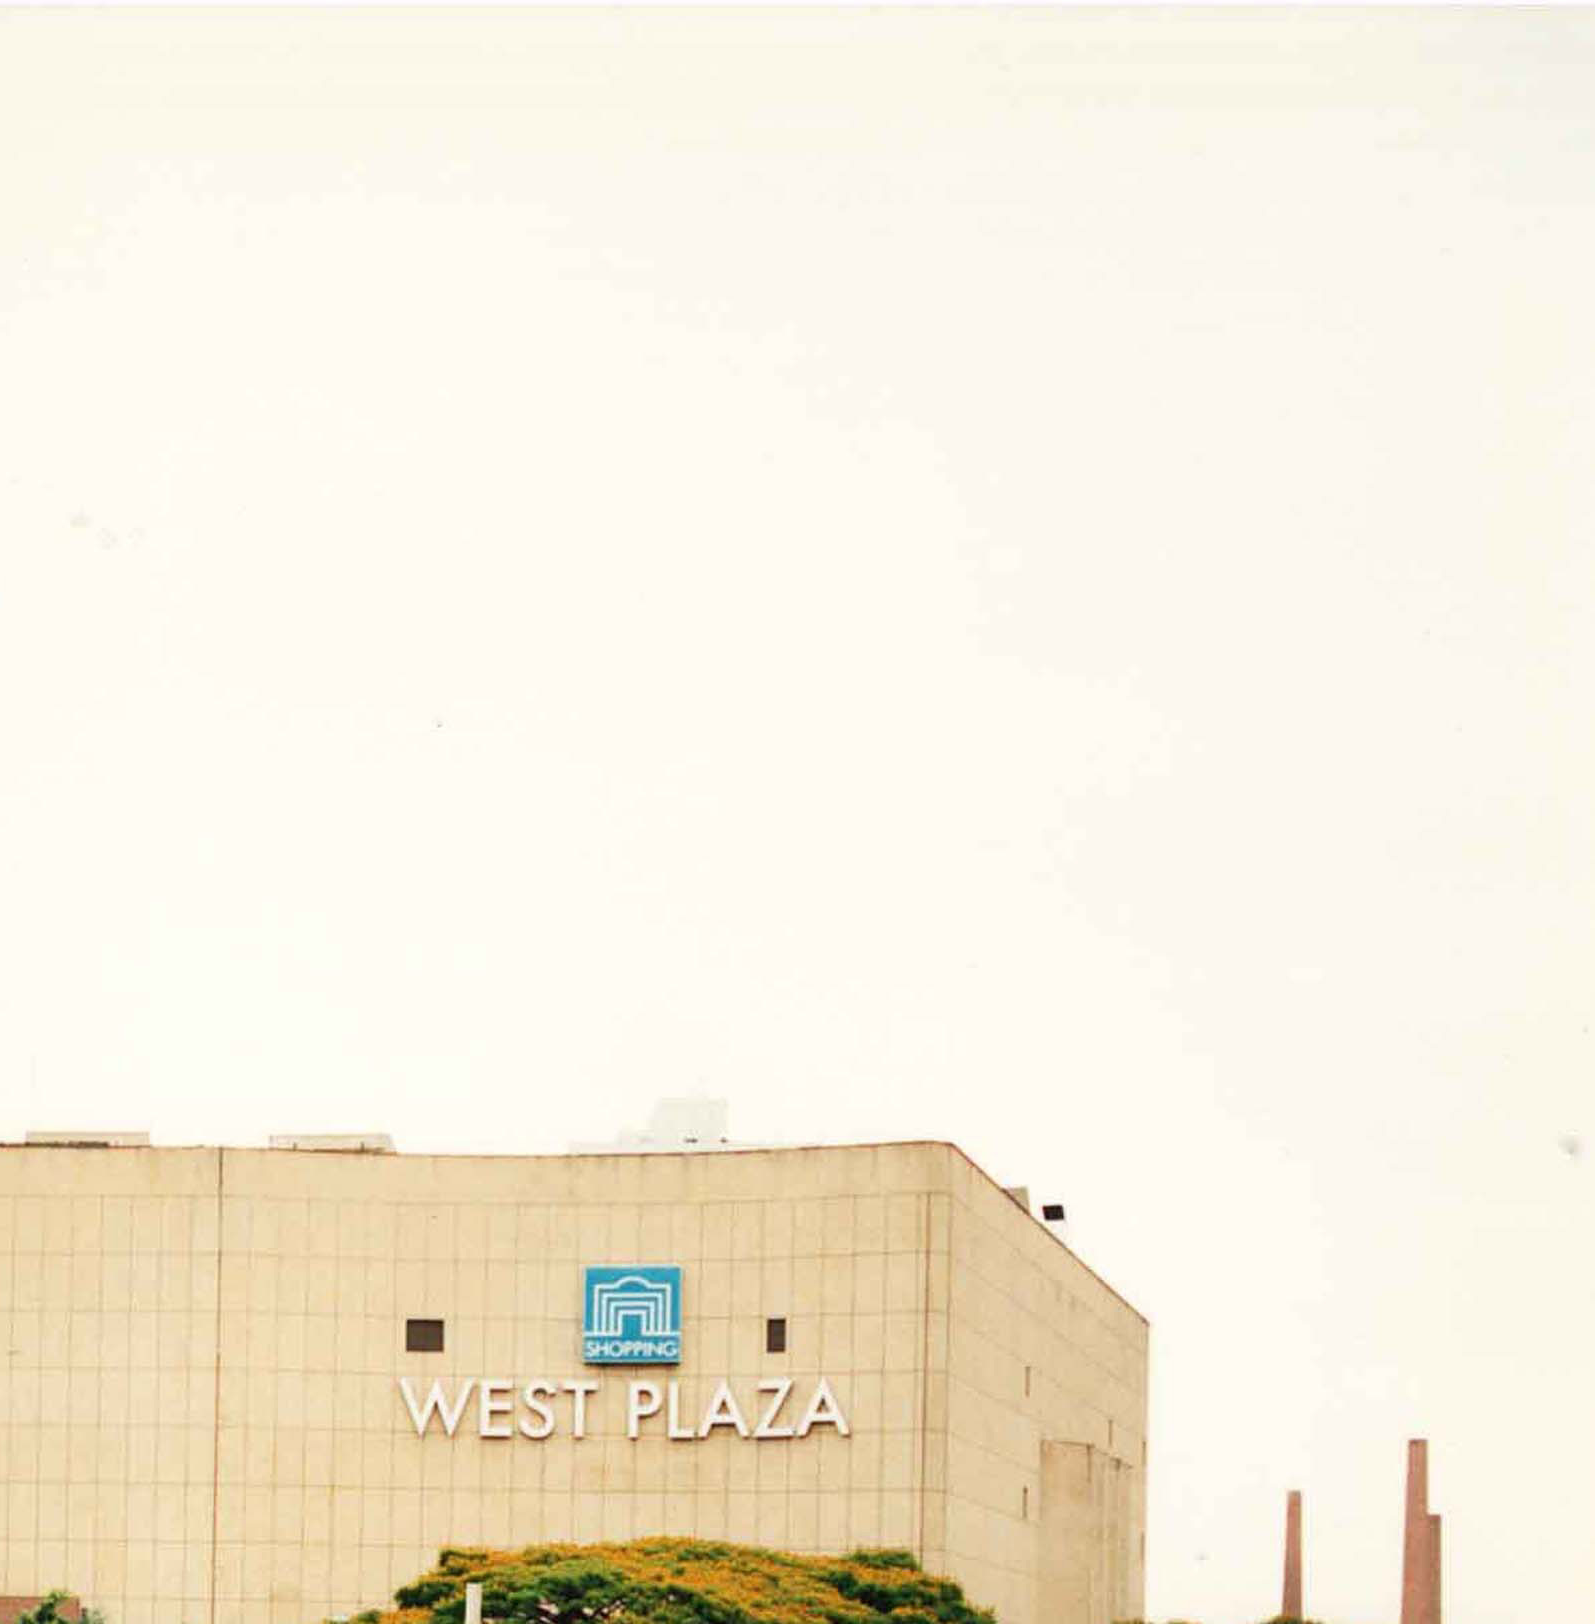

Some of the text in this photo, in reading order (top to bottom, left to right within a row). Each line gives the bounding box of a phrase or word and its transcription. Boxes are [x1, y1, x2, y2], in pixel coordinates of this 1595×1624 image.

[585, 1340, 678, 1357] SHOPPING
[399, 1377, 853, 1440] WEST PLAZA
